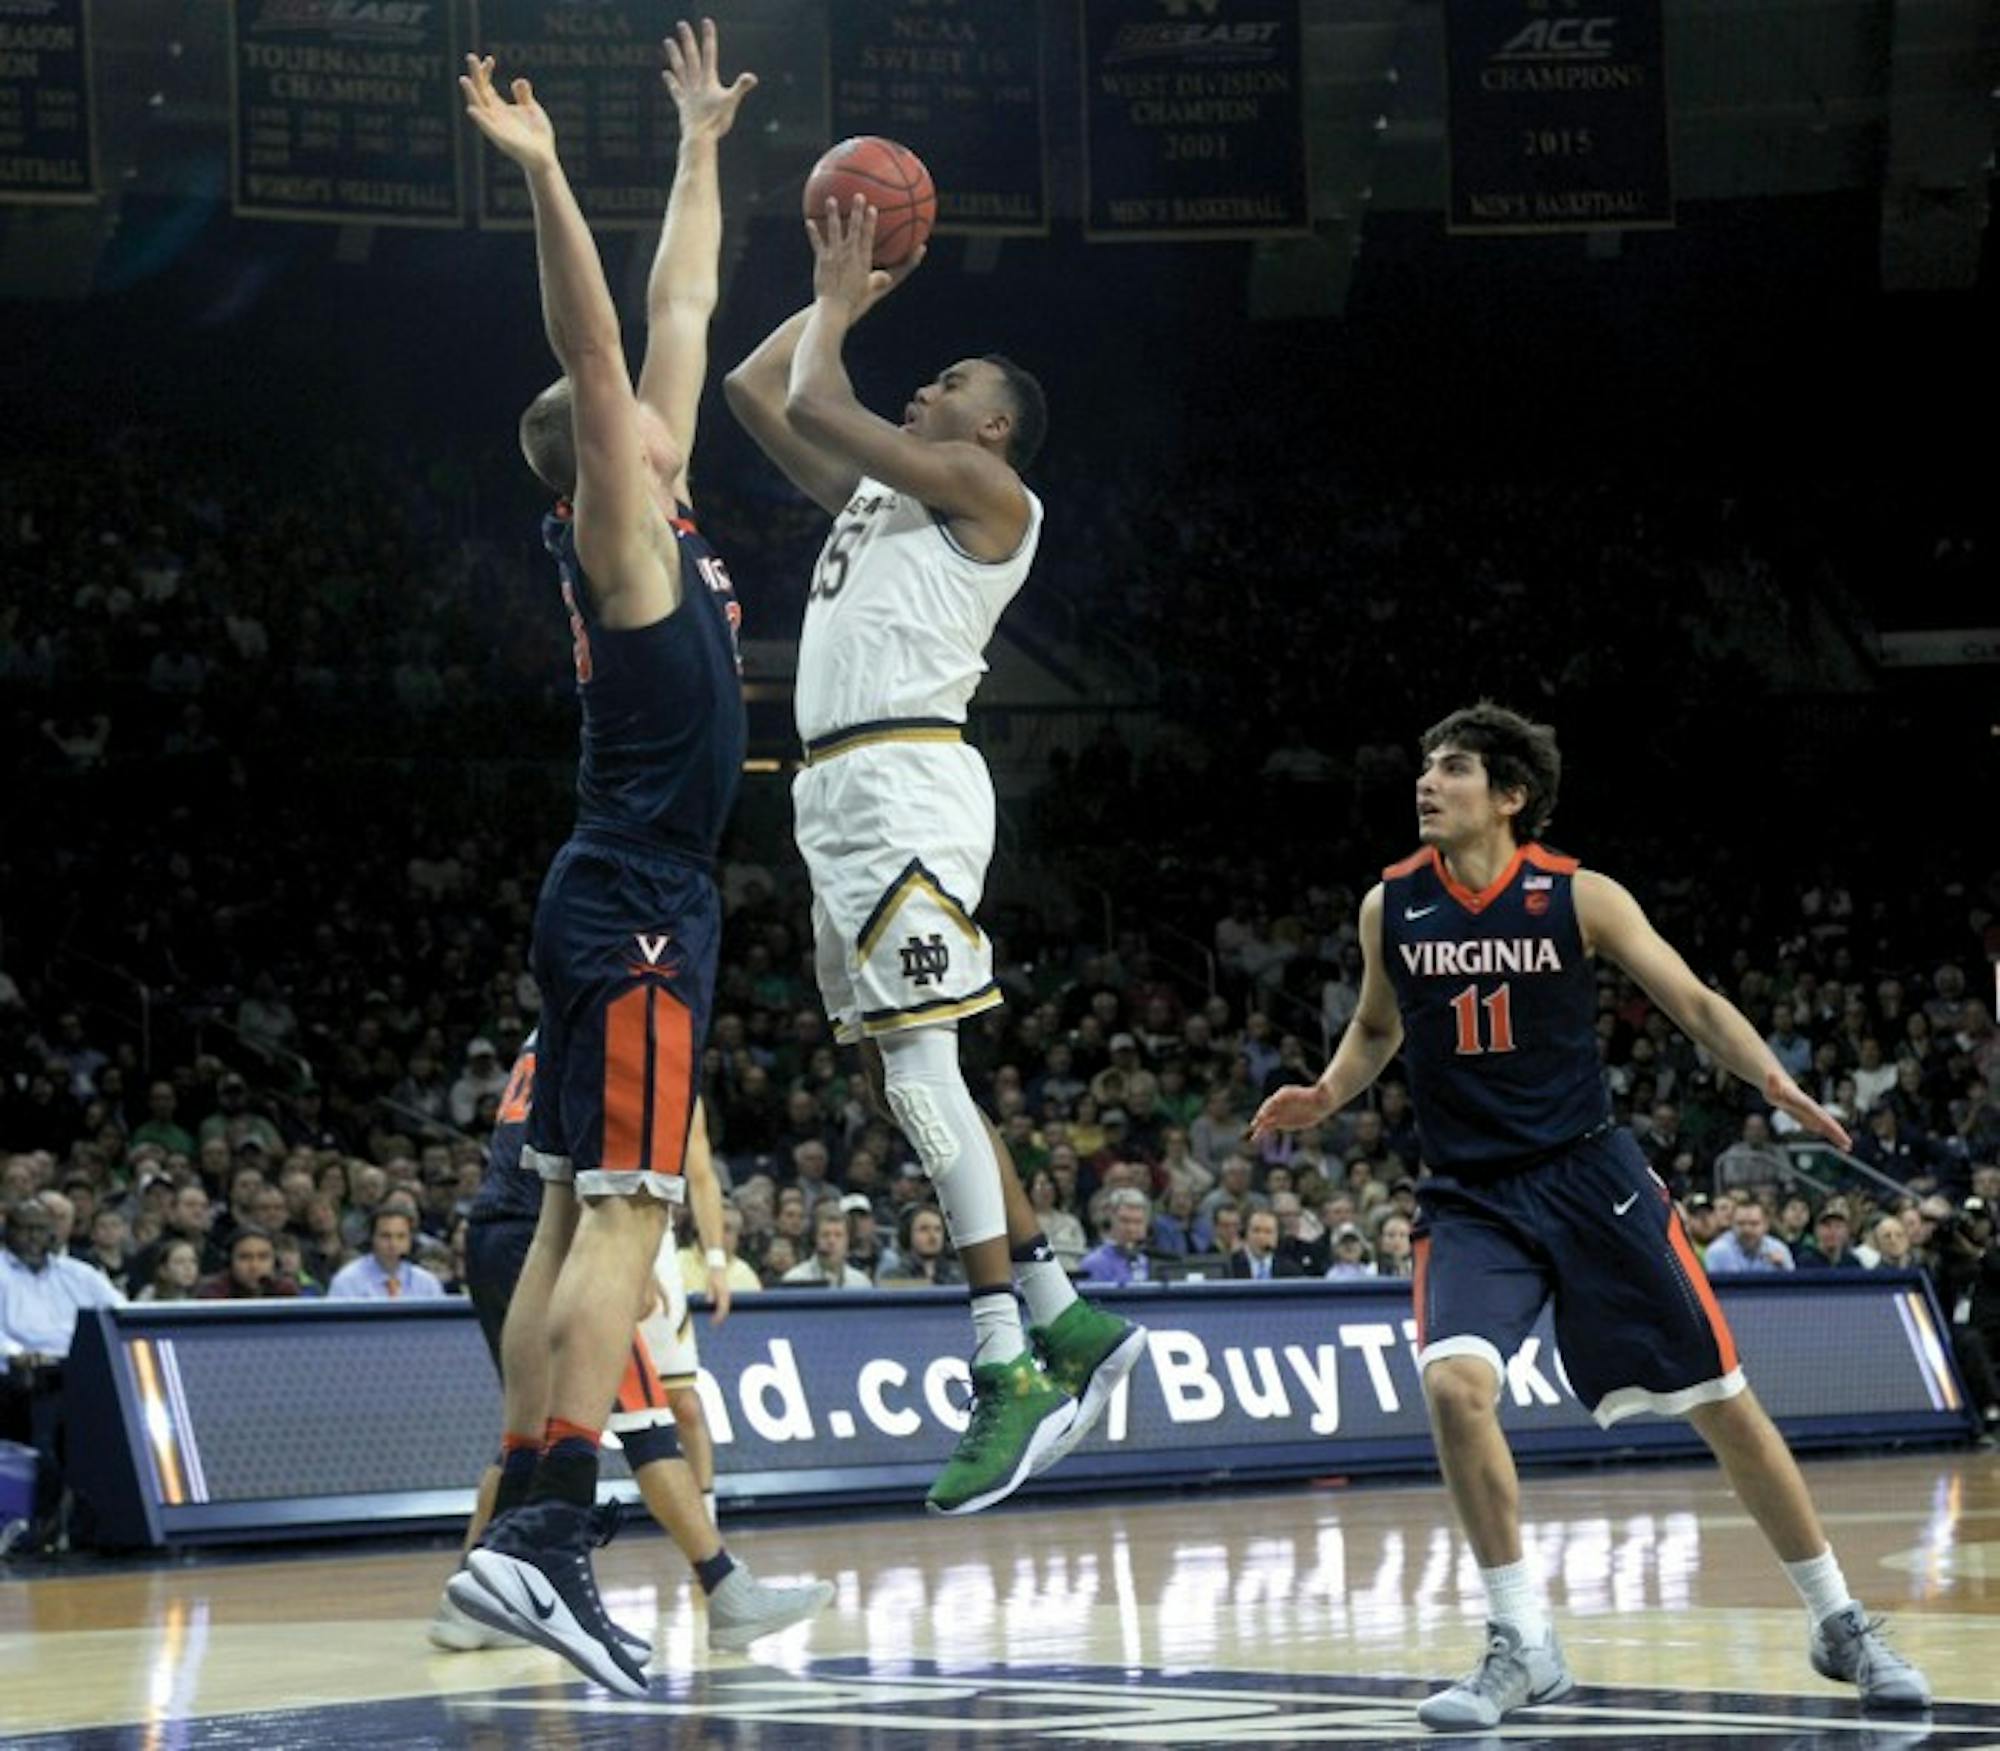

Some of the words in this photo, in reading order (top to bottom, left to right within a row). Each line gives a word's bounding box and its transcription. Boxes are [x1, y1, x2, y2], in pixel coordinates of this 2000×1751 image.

[545, 11, 633, 36] NCAA
[894, 16, 977, 42] NCAA
[1182, 22, 1281, 43] EAST
[1502, 17, 1620, 51] ACC
[242, 42, 443, 79] TOURNAMENT
[864, 47, 961, 73] SWEET
[268, 72, 421, 104] CHAMPION
[1101, 72, 1168, 97] WEST
[1175, 67, 1290, 96] DIVISION
[1130, 97, 1259, 125] CHAMPION
[1164, 133, 1232, 161] 2001
[1522, 127, 1594, 156] 2015
[1108, 199, 1167, 223] MEN'S
[1173, 195, 1288, 222] BASKETBALL
[634, 933, 670, 965] V
[1400, 938, 1563, 976] VIRGINIA
[1449, 981, 1517, 1056] 11
